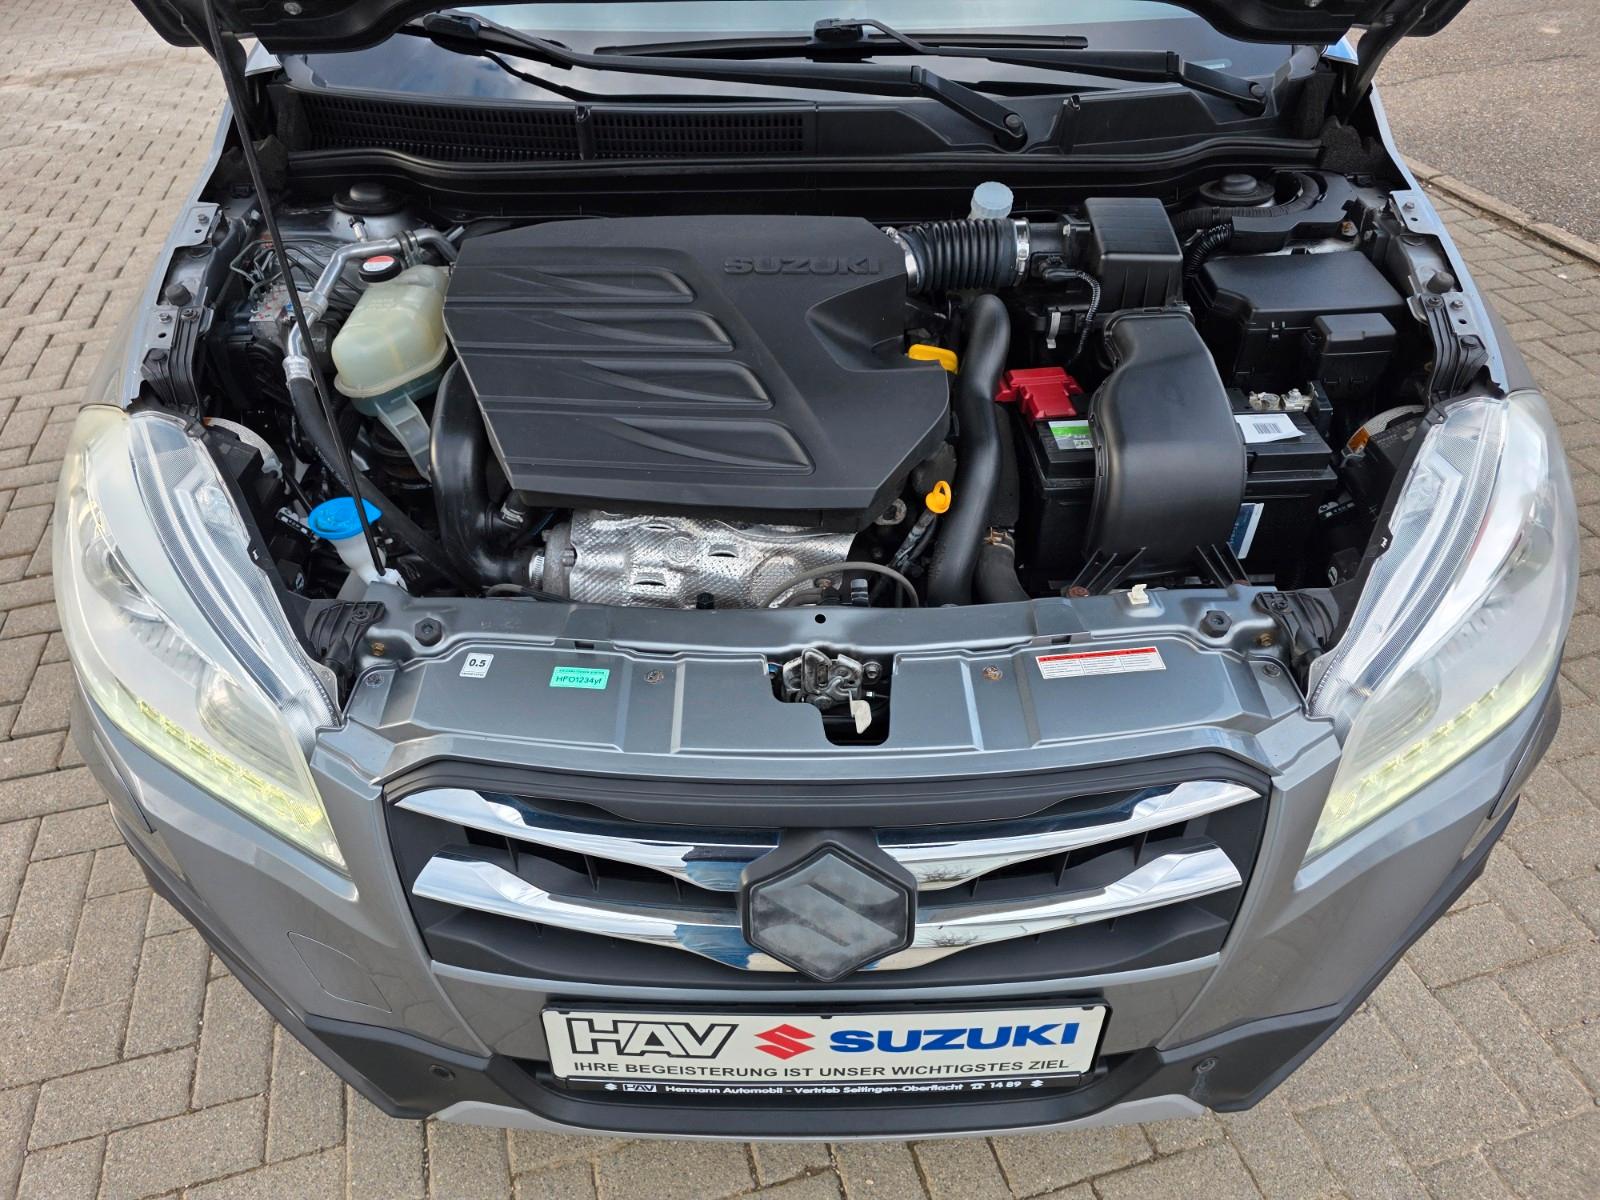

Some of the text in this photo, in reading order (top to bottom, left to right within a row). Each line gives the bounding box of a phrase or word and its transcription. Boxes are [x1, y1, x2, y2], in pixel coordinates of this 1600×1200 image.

[724, 256, 880, 275] SUZUKI
[469, 659, 486, 667] 0.5
[566, 1018, 739, 1059] HAV
[830, 1023, 1080, 1053] SUZUKI
[574, 1060, 1069, 1077] IHRE BEGEISTERUNG IST UNSER WICHTIGSTES ZIEL
[665, 1086, 721, 1094] Hermann
[724, 1086, 783, 1094] Automobil
